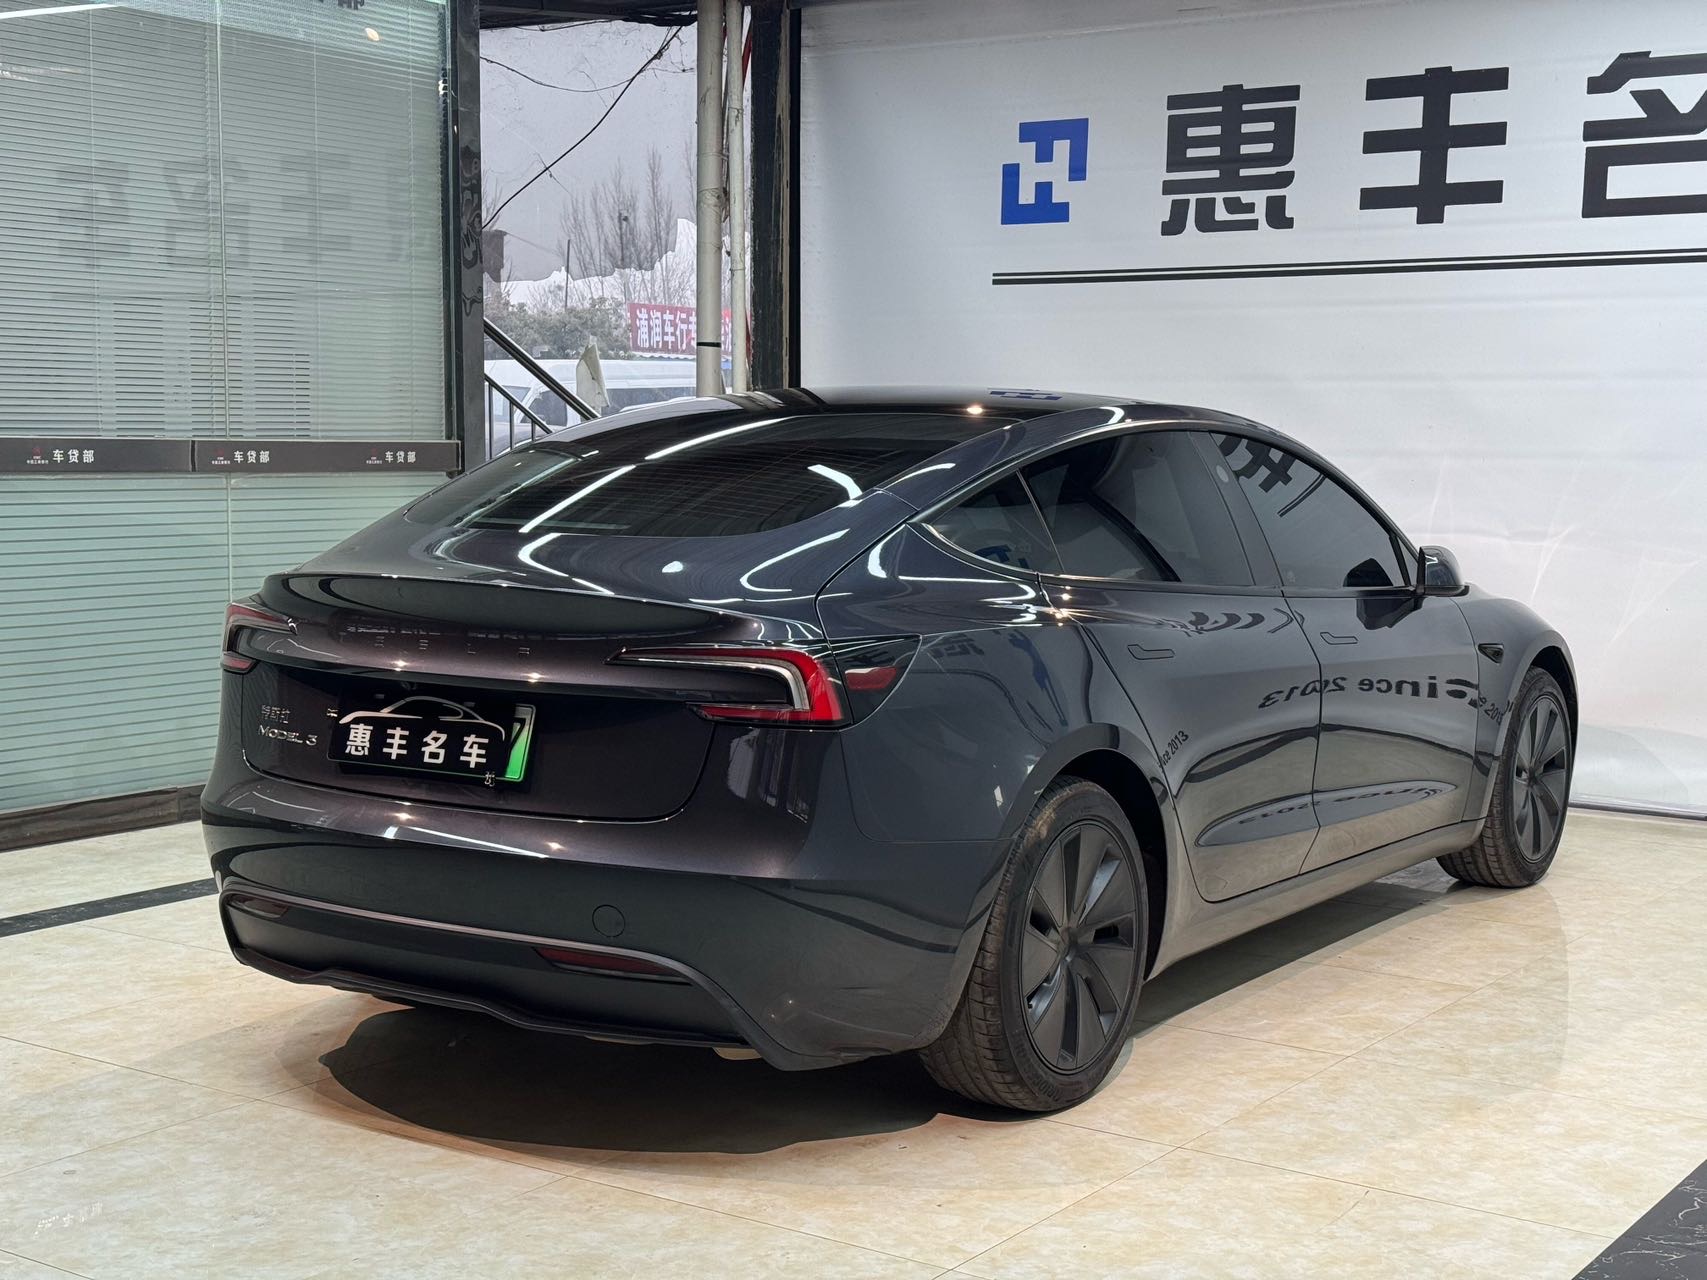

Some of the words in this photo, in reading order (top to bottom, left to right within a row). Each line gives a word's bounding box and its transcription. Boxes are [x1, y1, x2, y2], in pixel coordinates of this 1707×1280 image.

[52, 449, 95, 464] 车贷部
[233, 450, 270, 464] 车贷部
[384, 450, 417, 464] 车贷部
[258, 724, 304, 744] MODEL
[305, 734, 318, 746] 3
[344, 722, 490, 769] 惠丰名车
